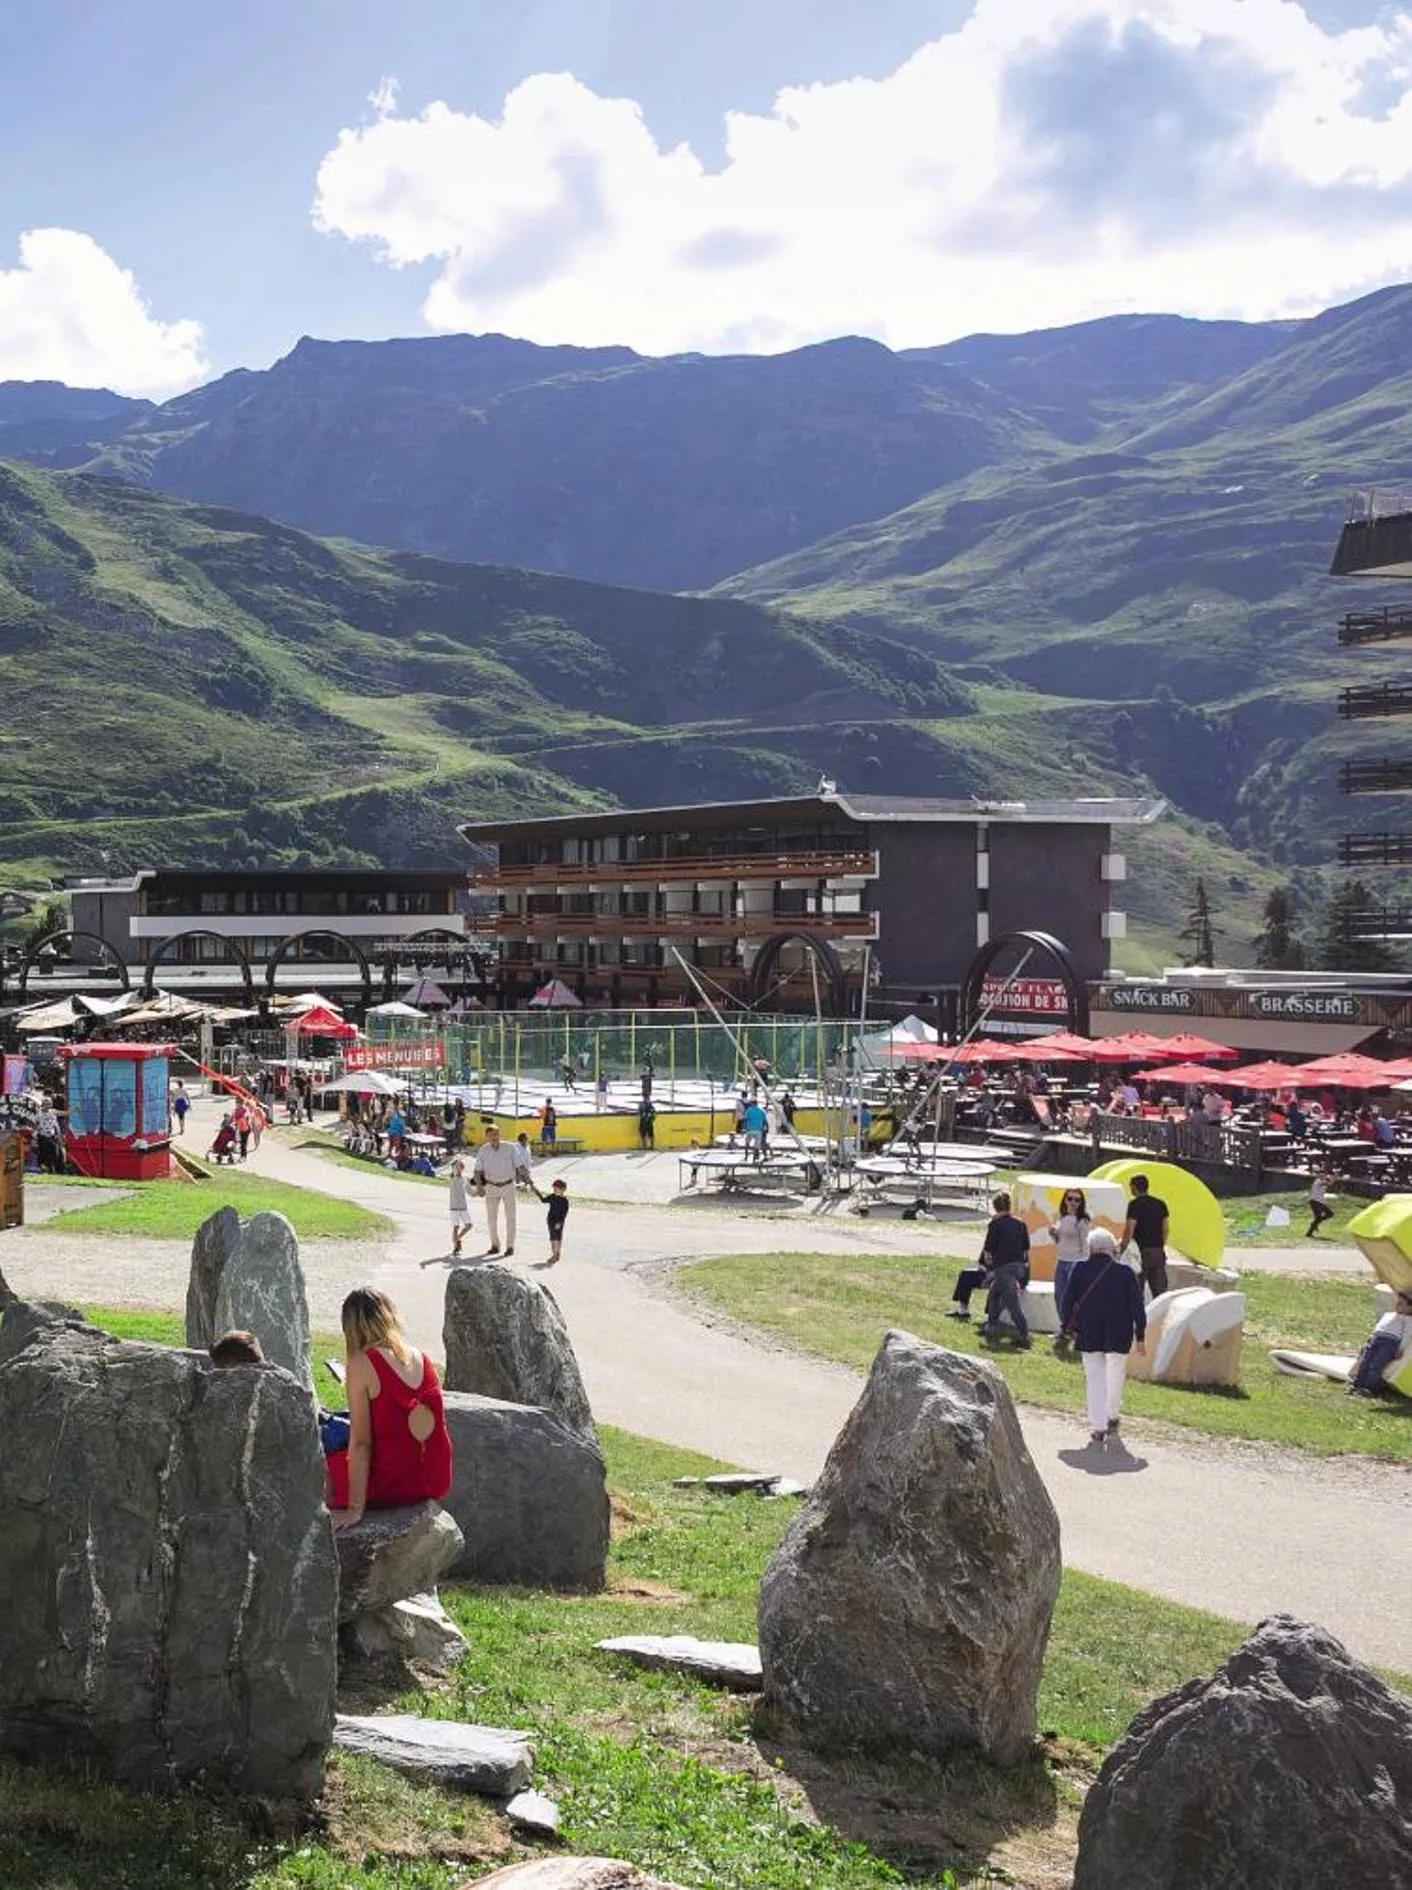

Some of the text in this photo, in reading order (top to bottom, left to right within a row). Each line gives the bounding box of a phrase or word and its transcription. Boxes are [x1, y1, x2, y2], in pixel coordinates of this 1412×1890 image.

[1113, 991, 1189, 1007] SNACK BAR
[1260, 996, 1354, 1015] BRASSERIE
[347, 1052, 373, 1066] LES
